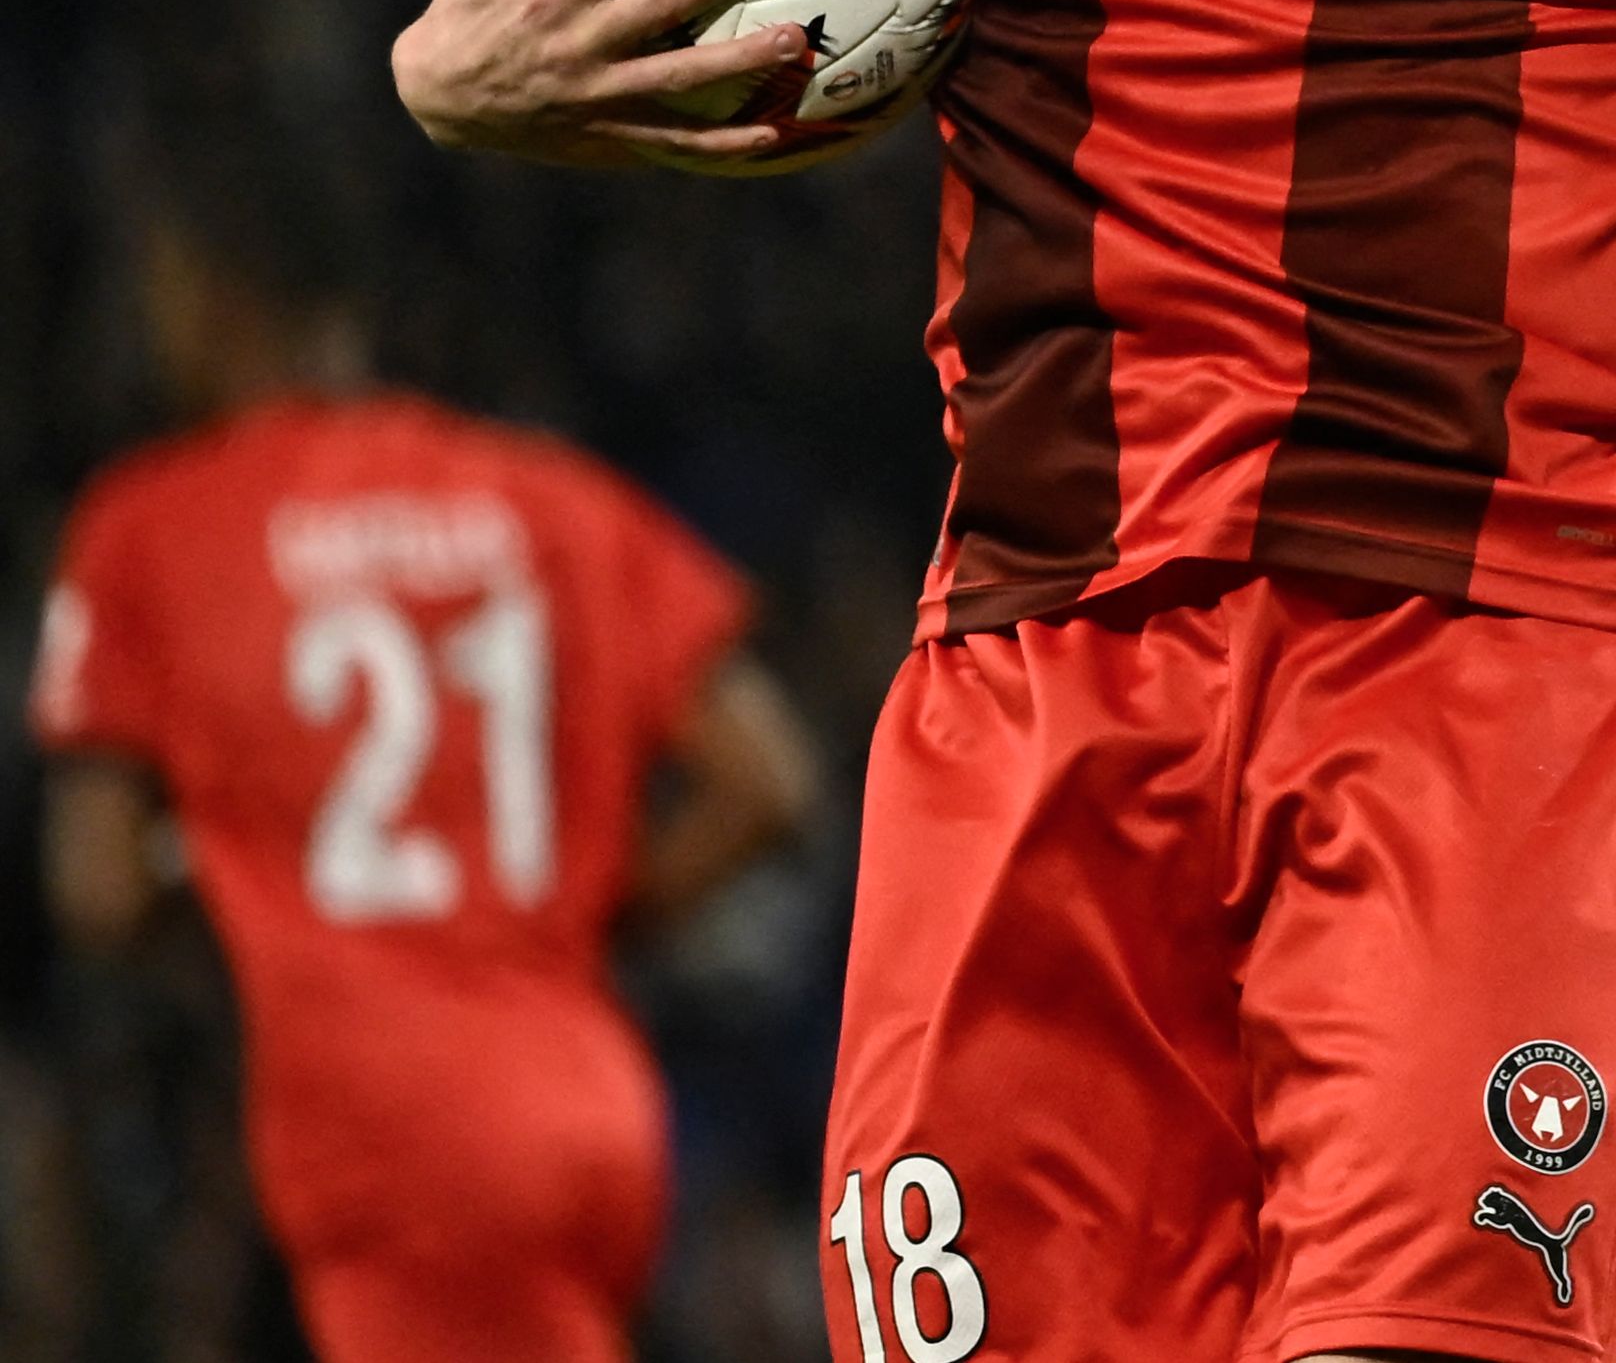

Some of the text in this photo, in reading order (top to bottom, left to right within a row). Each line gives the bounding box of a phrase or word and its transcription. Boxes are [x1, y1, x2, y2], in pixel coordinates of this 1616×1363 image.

[289, 599, 555, 922] 21
[1494, 1047, 1602, 1111] FC MIDTJYLLAND
[1524, 1149, 1563, 1168] 1999
[830, 1154, 987, 1363] 18
